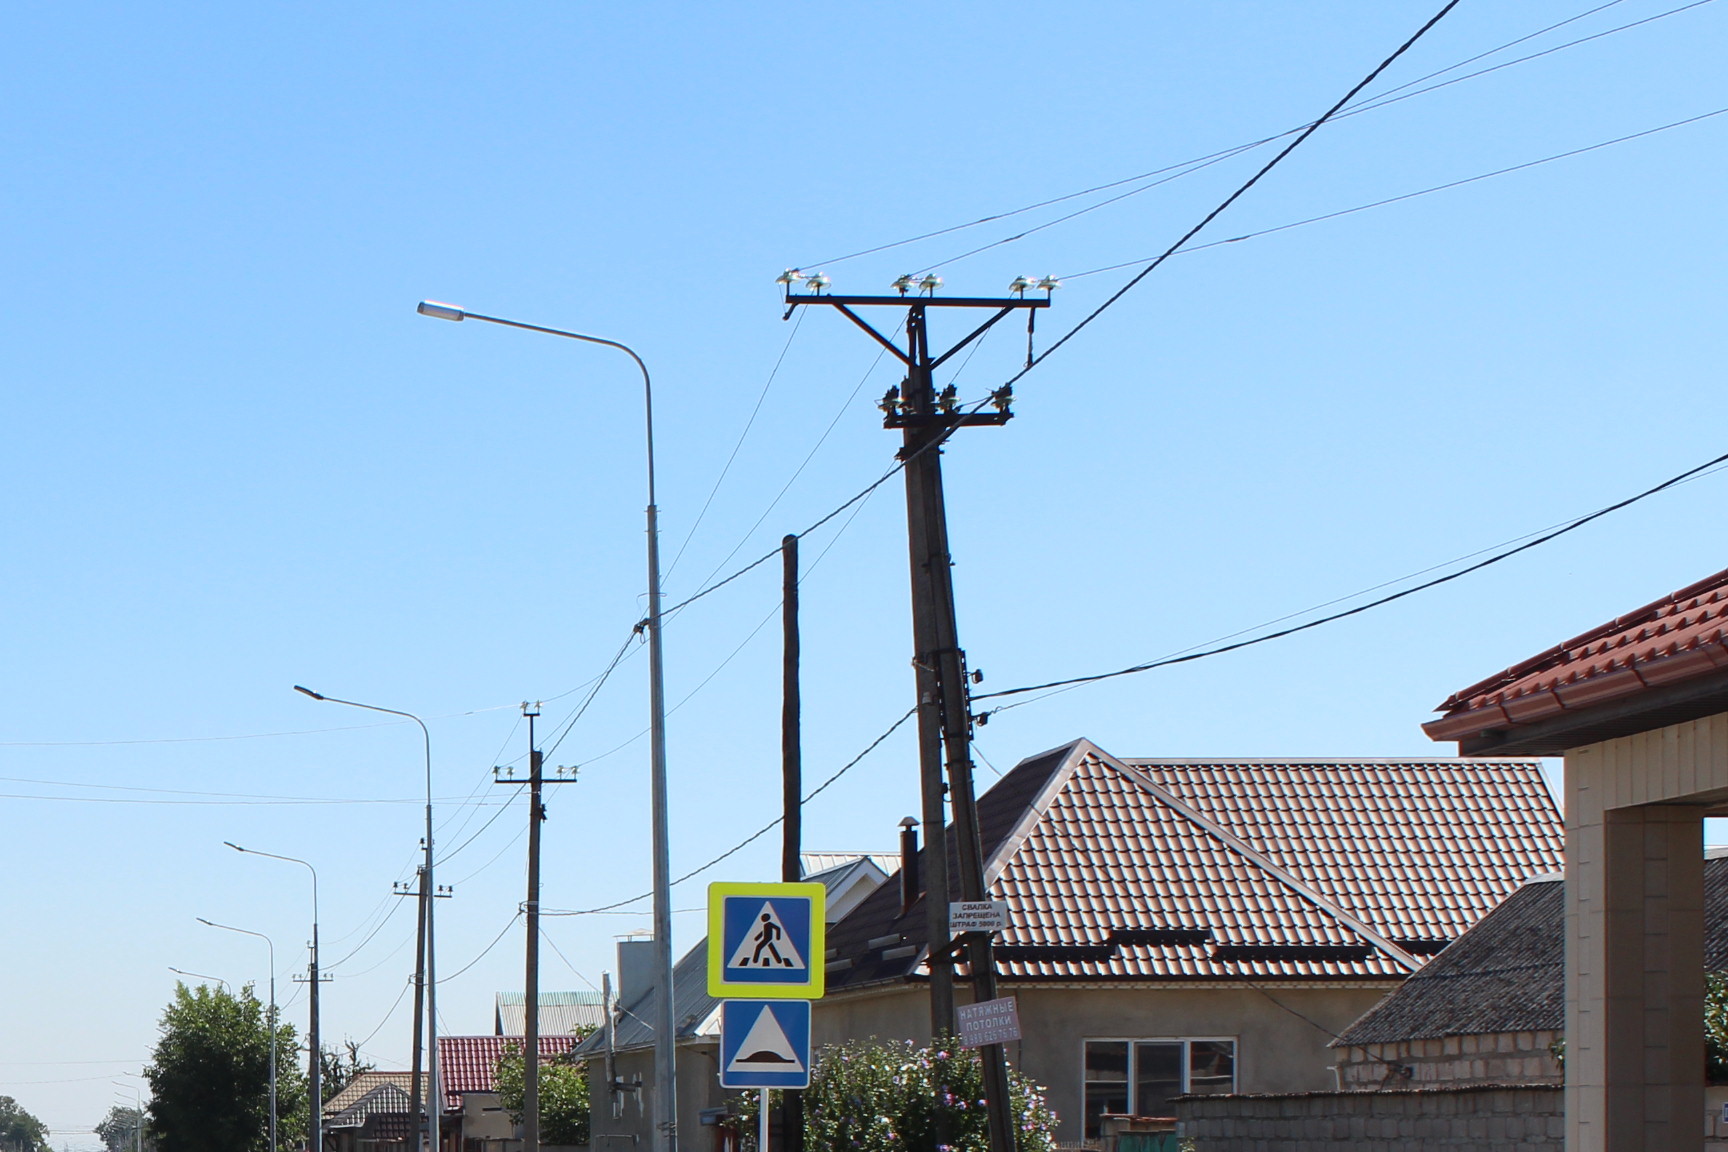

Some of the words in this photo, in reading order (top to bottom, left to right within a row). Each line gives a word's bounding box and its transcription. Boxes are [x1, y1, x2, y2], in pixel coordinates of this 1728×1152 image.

[962, 903, 992, 911] СВАЛКА
[952, 911, 1001, 920] ЗАПРЕЩЕНА
[960, 1001, 1014, 1020] НАТЯЖНЫЕ
[966, 1015, 1012, 1032] ПОТОЛКИ
